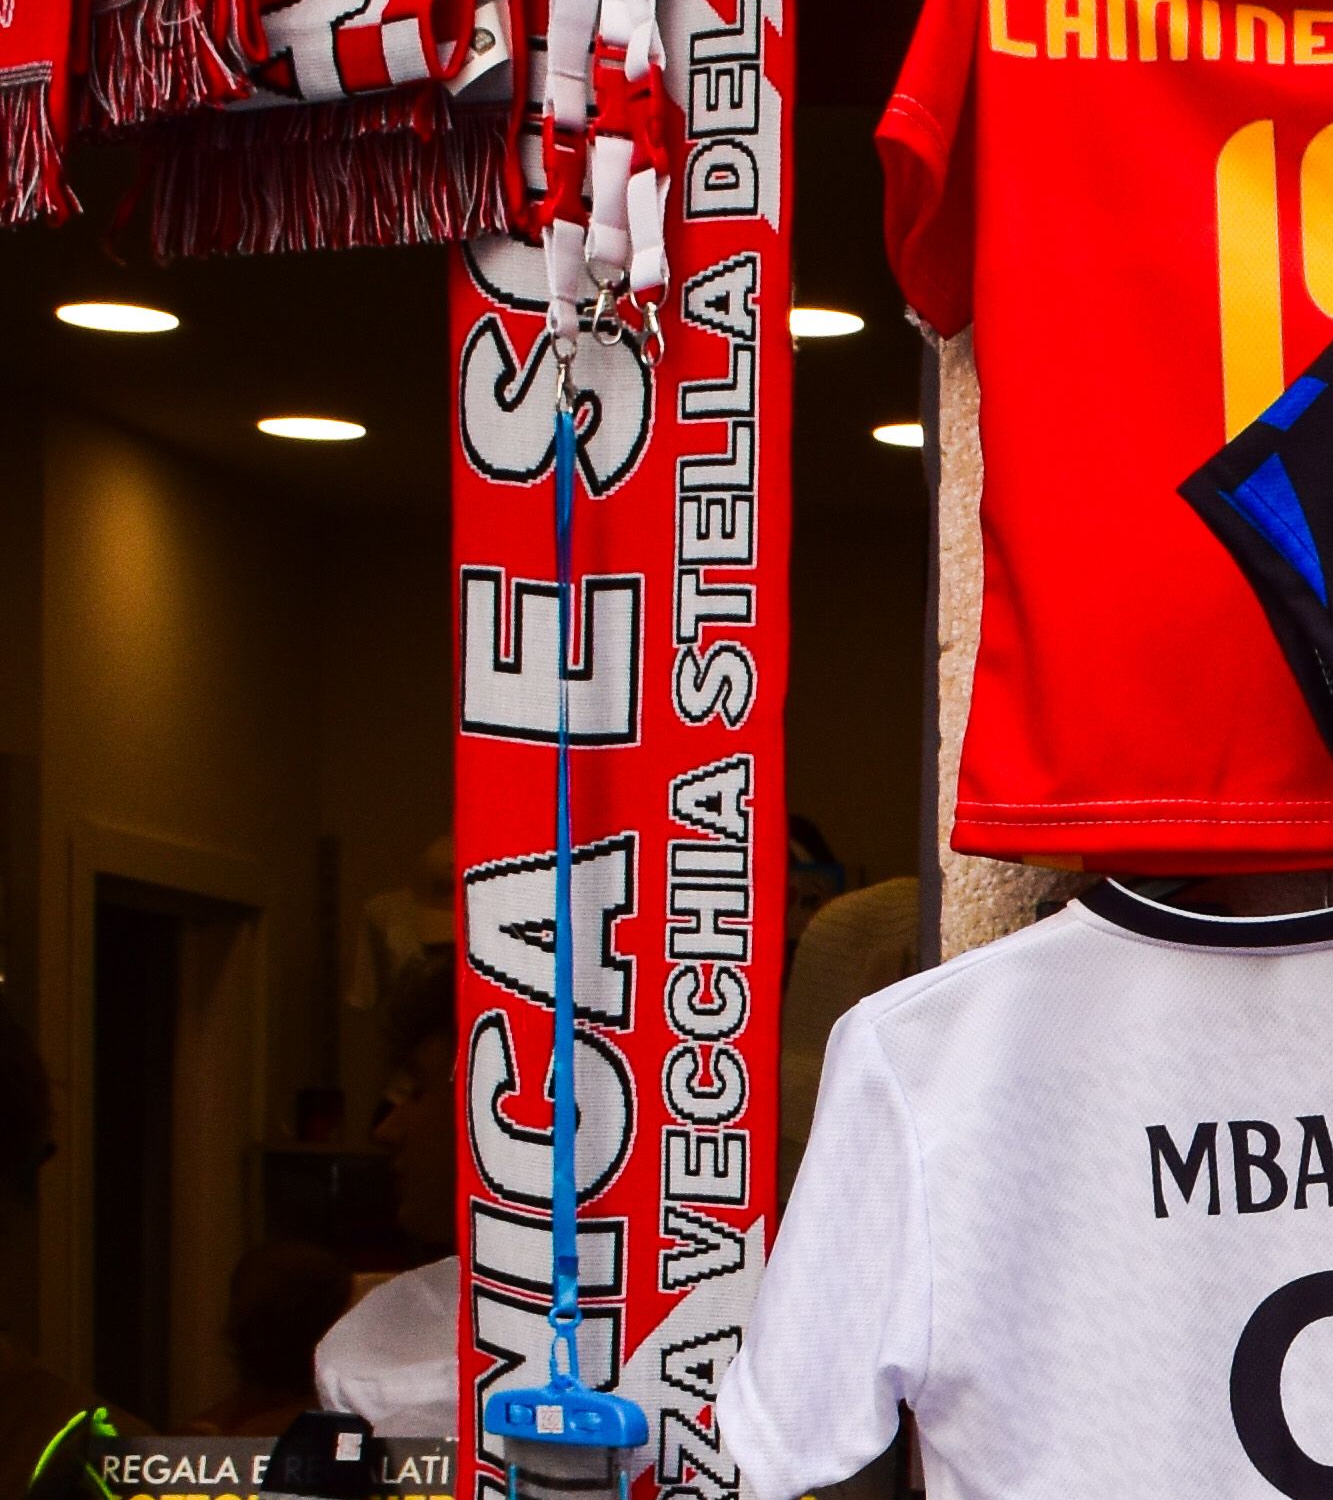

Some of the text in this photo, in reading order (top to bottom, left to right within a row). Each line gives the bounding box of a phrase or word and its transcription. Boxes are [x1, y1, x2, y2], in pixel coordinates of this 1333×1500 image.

[675, 252, 760, 728] STELLA
[659, 755, 753, 1291] VECCHIA
[102, 1455, 241, 1485] REGALA
